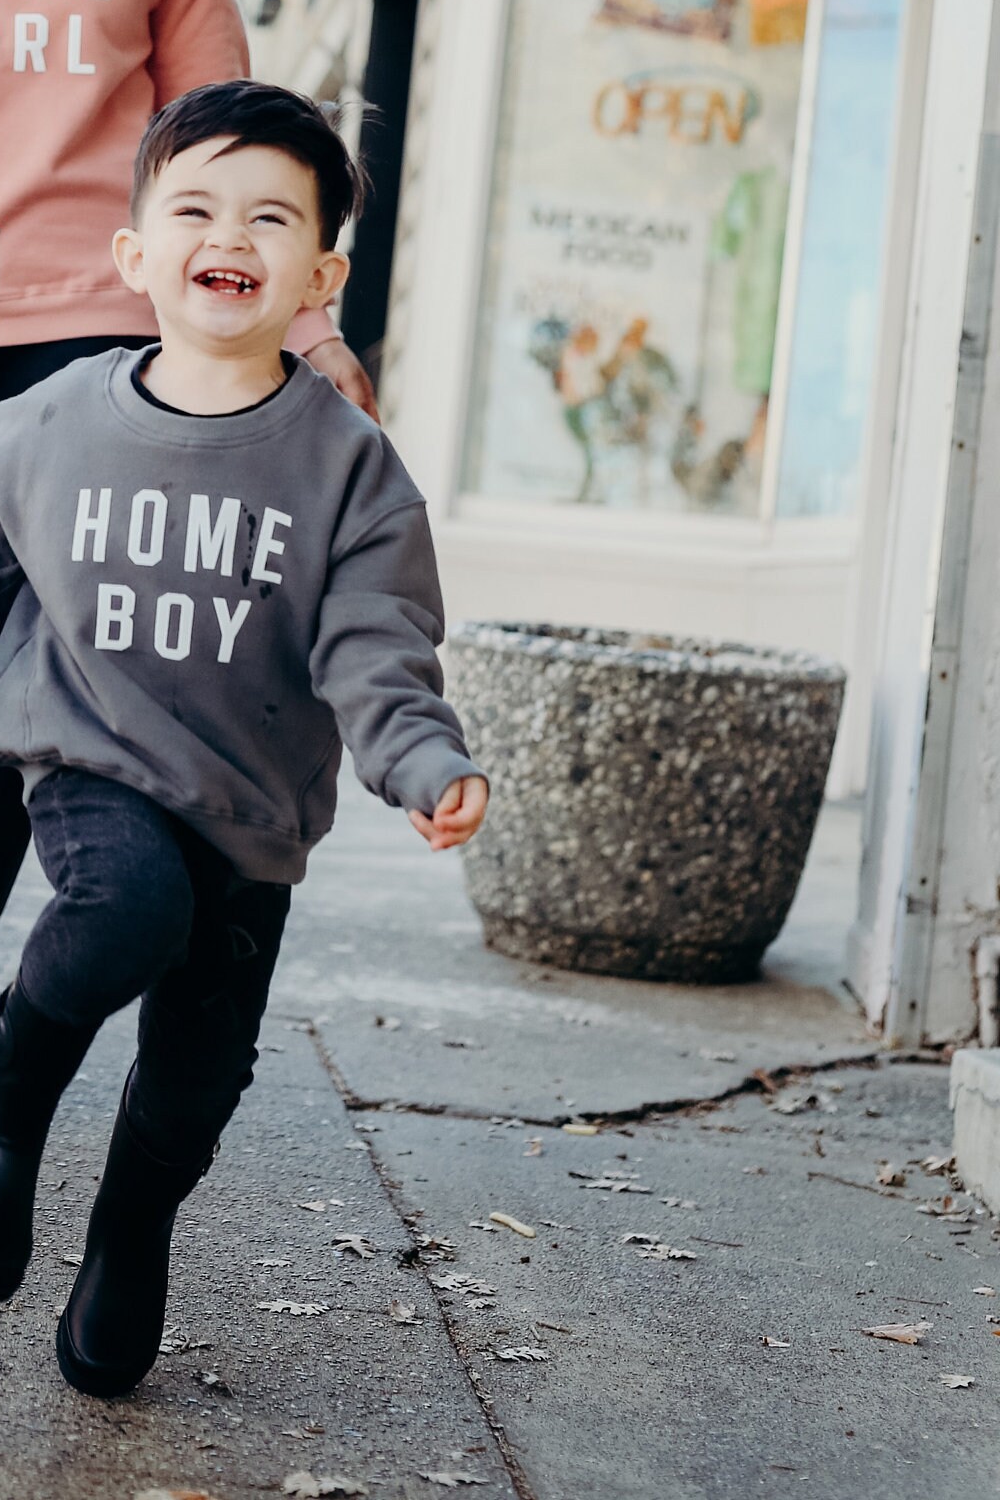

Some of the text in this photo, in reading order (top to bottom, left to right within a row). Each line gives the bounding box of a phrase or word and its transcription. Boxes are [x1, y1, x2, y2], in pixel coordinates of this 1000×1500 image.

[590, 78, 748, 146] OPEN
[71, 488, 293, 585] HOME
[94, 583, 252, 664] BOY
